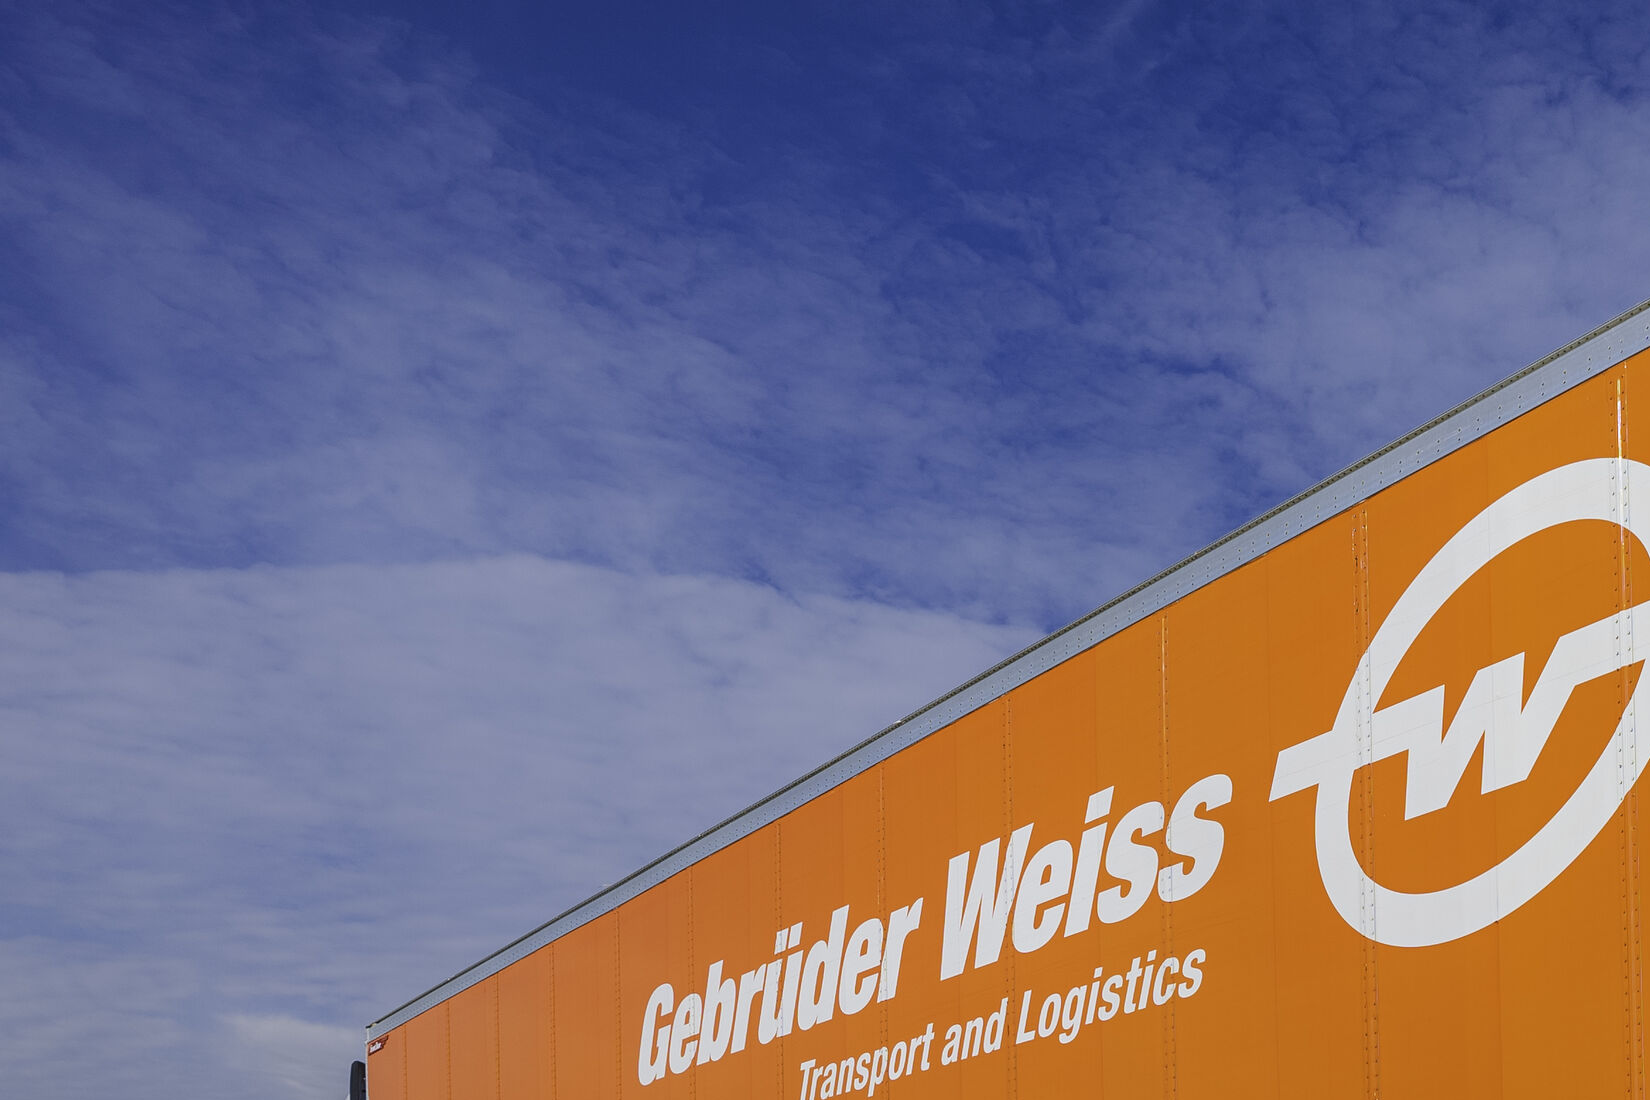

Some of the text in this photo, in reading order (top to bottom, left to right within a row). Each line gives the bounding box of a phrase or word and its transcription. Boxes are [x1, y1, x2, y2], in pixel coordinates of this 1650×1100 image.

[638, 774, 1233, 1086] Gebrüder Weiss
[941, 998, 1008, 1066] and
[1016, 949, 1206, 1045] Logistics
